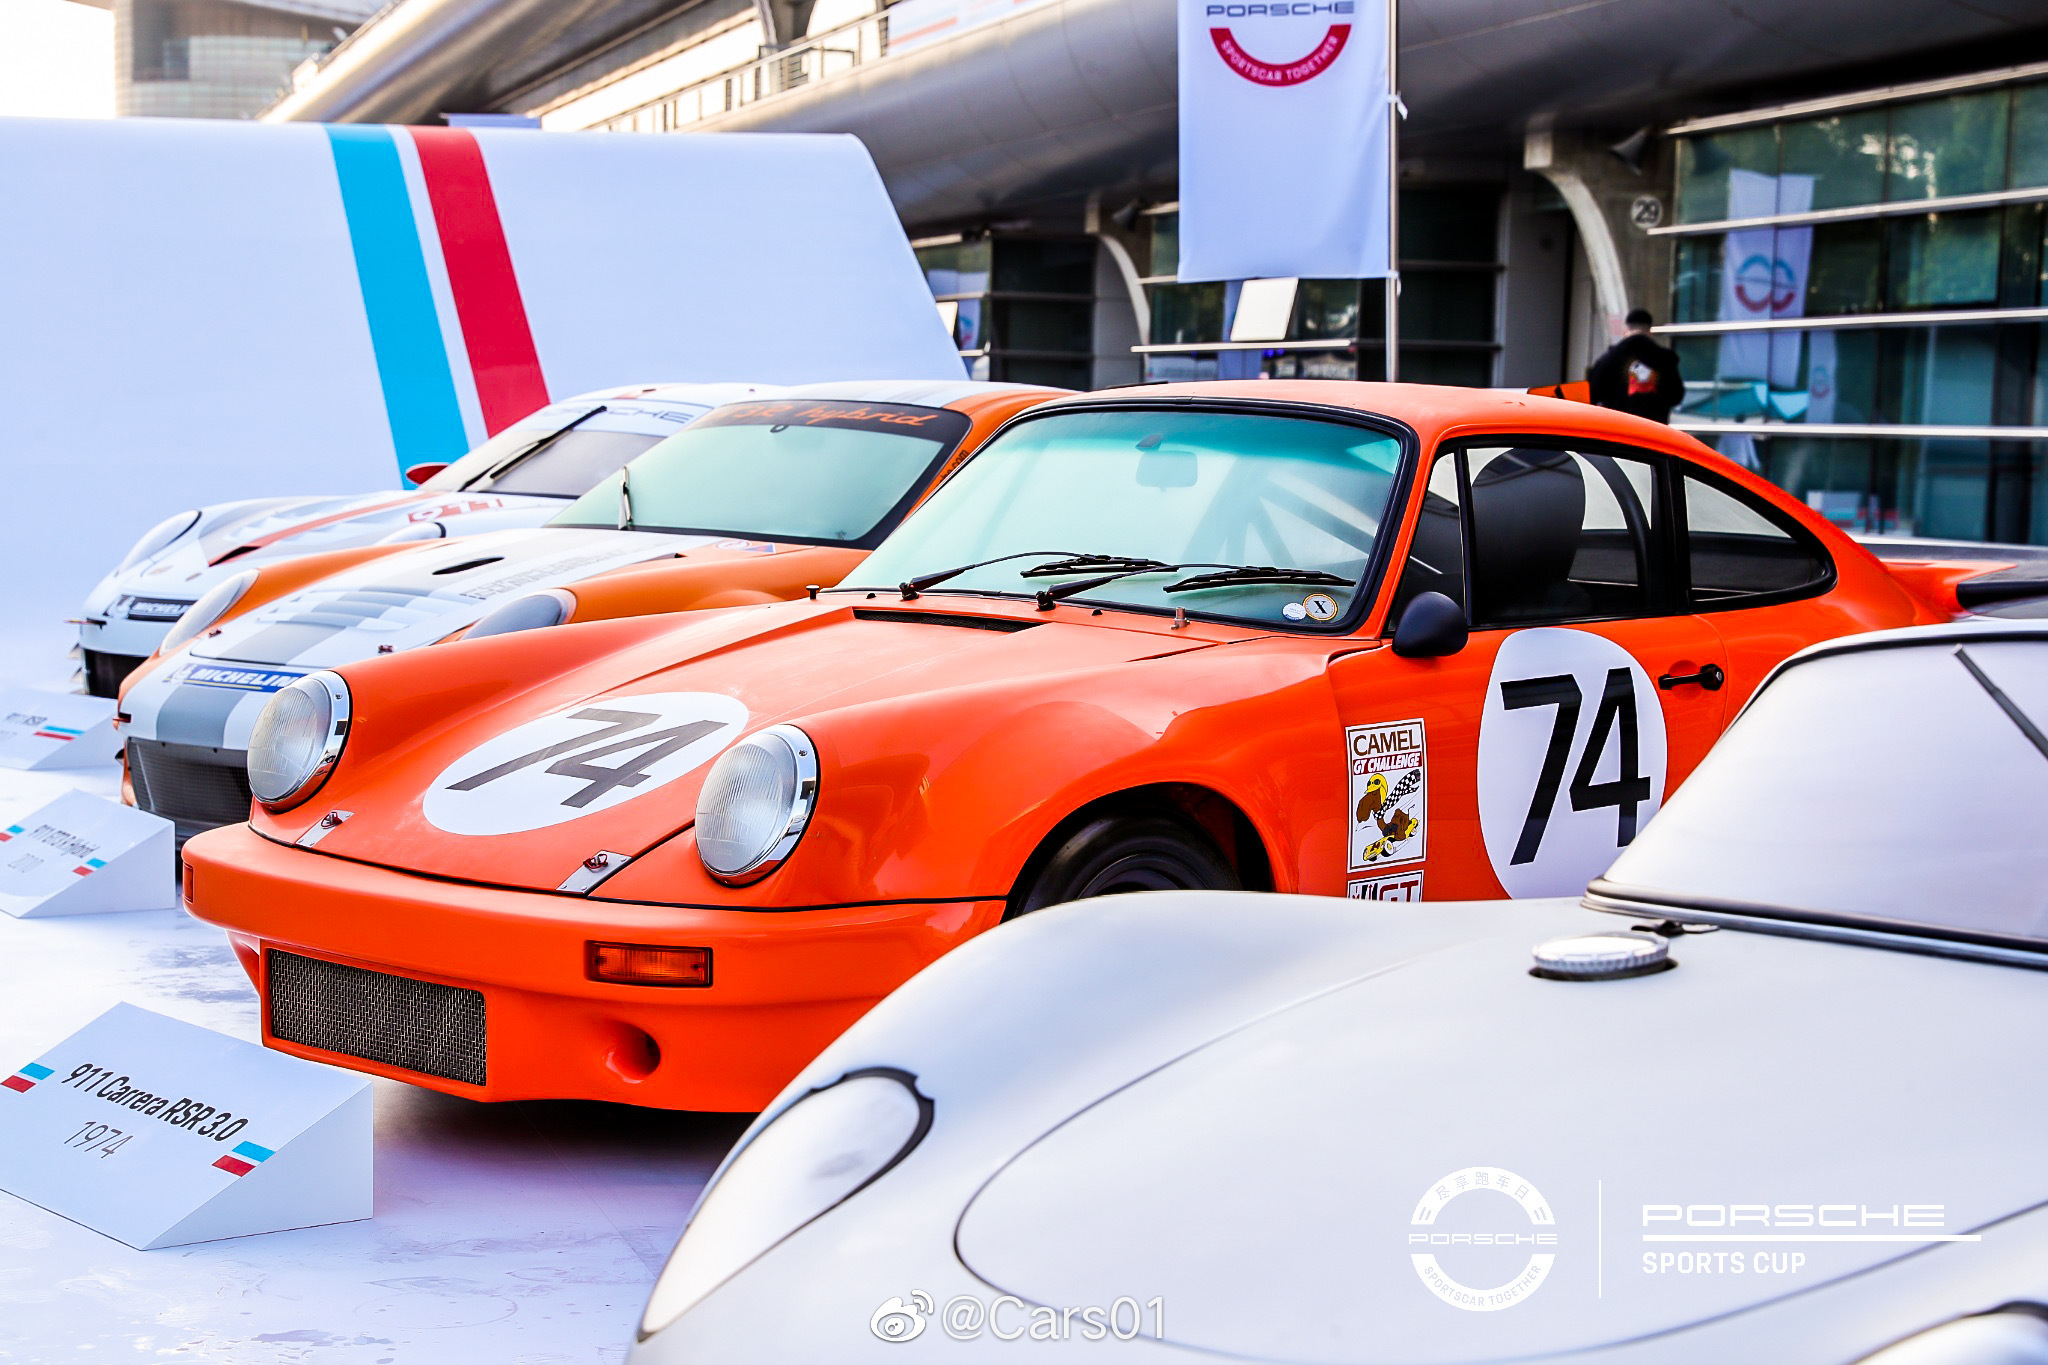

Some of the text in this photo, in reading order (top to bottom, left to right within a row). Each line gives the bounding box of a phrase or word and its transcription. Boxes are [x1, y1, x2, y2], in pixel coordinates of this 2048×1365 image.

[1206, 1, 1354, 17] PORSCHE
[1220, 35, 1339, 82] SPORTSCAR TOGETHER
[1635, 200, 1659, 223] 29
[796, 405, 938, 426] hybrid
[1313, 600, 1328, 614] X
[194, 667, 296, 687] MICHELIN
[1353, 729, 1421, 756] CAMEL
[445, 708, 729, 808] 74
[1354, 752, 1421, 774] GT CHALLENGE
[1500, 667, 1651, 866] 74
[61, 1063, 249, 1141] 911 Carrera RSR 3.0
[63, 1121, 134, 1159] 1974
